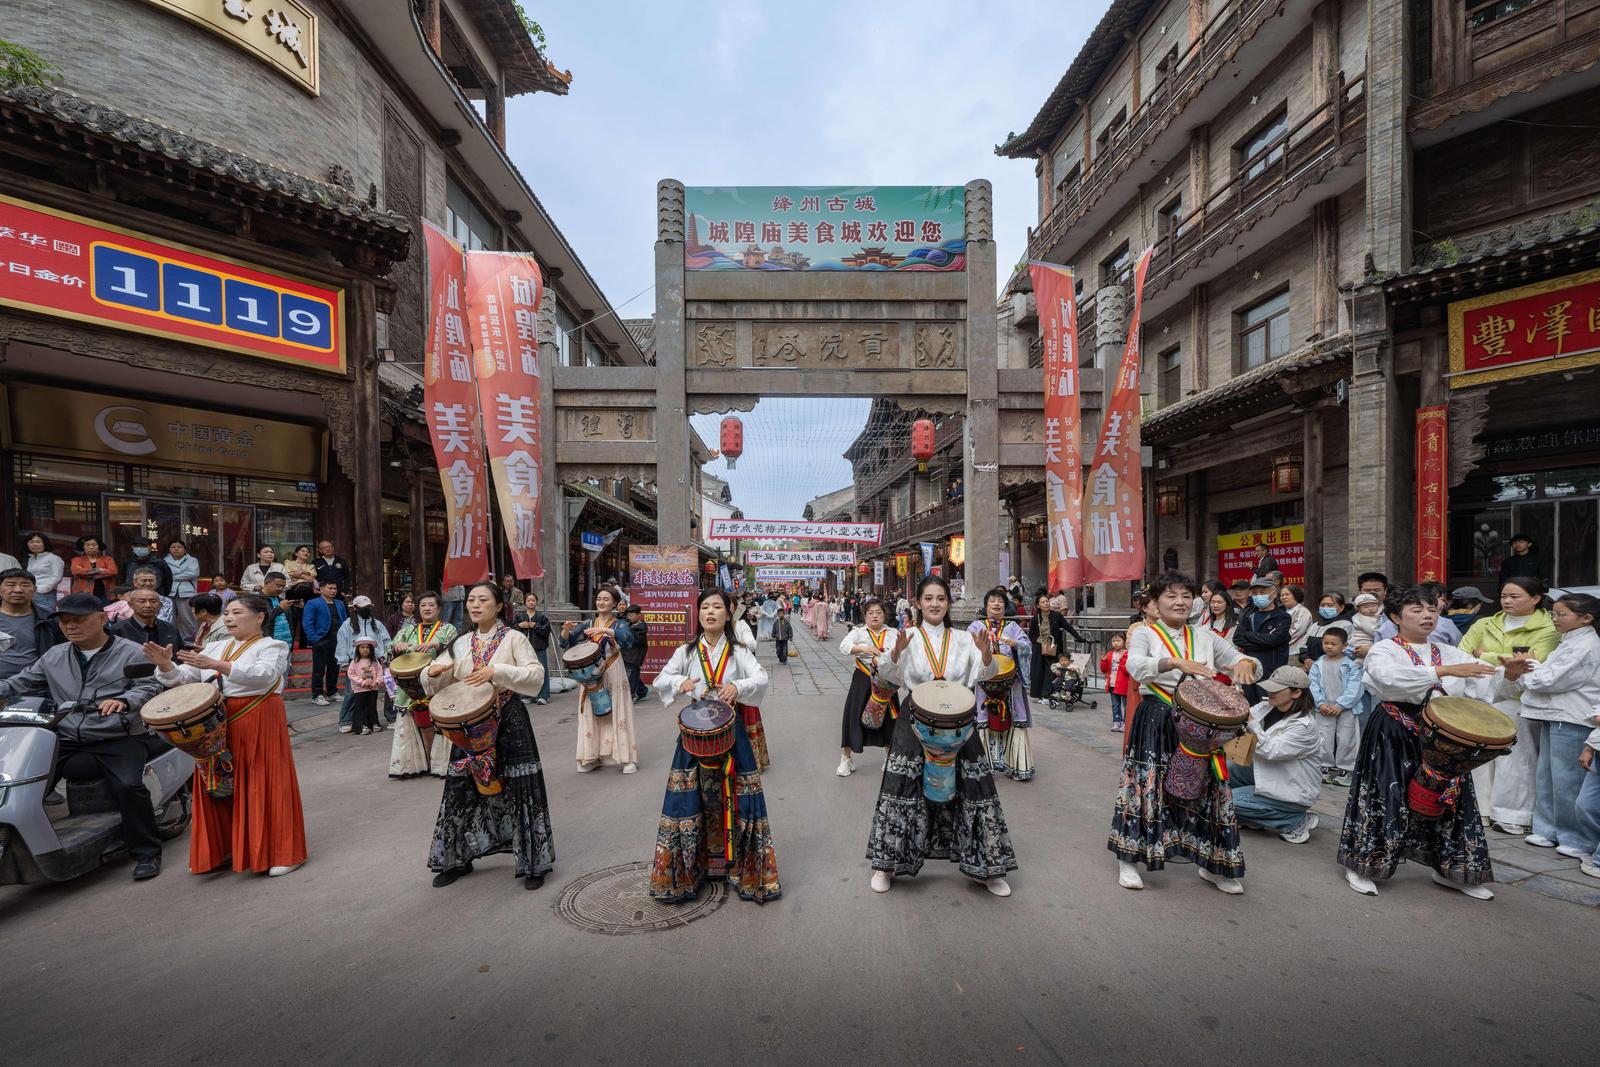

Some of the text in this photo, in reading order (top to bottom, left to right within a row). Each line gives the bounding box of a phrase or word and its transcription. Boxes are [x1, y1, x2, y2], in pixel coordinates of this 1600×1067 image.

[772, 195, 877, 213] 绛州古城
[708, 220, 943, 244] 城隍庙美食城欢迎您
[0, 261, 86, 288] 日金价
[111, 266, 321, 335] 1119
[1472, 300, 1600, 361] 豐澤
[168, 420, 256, 447] 中国黄金
[1240, 529, 1291, 547] 公寓出租
[633, 568, 694, 589] 非遗打铁花
[643, 613, 686, 623] 晚8:00
